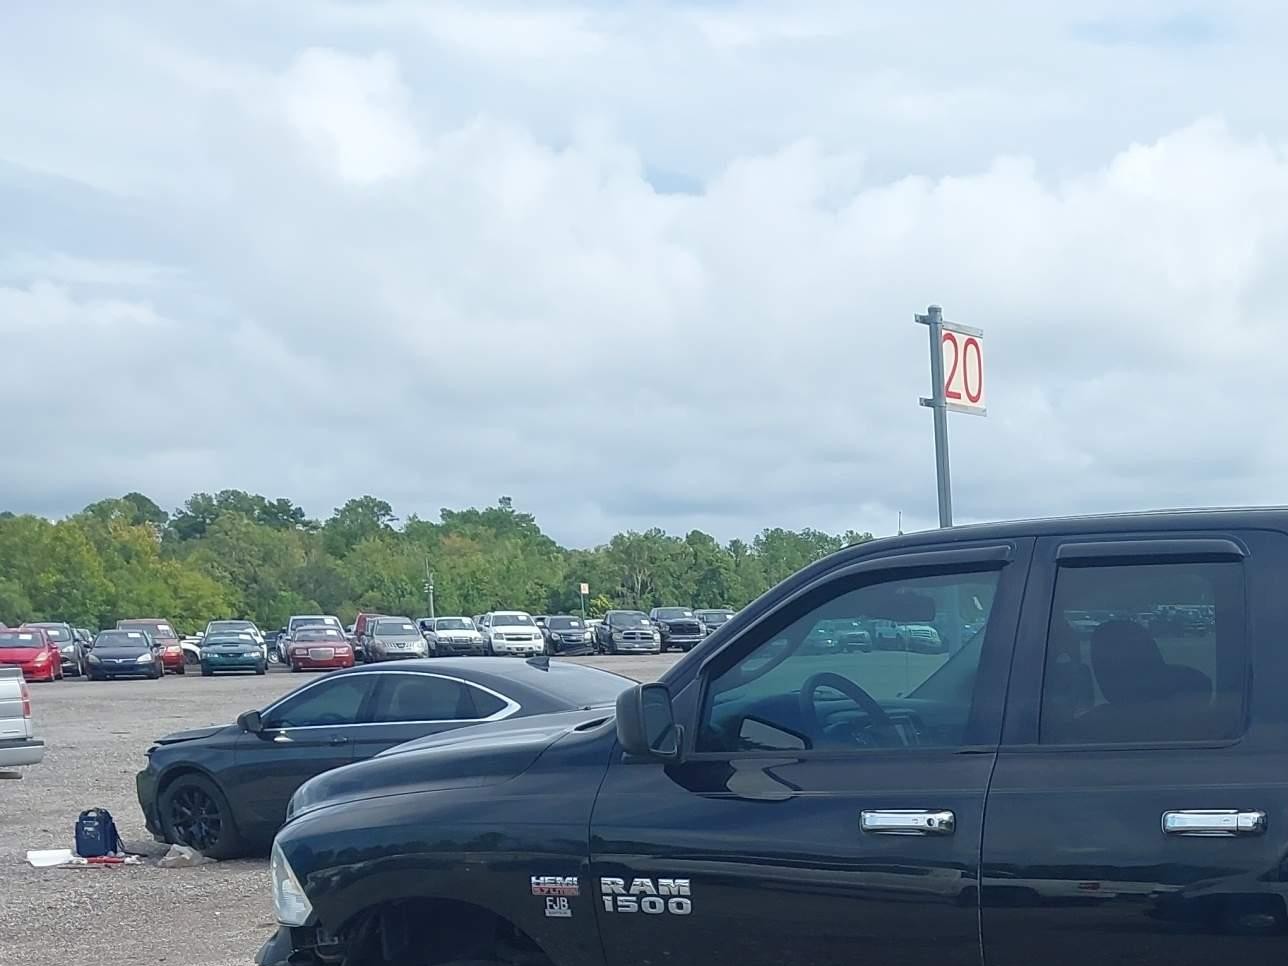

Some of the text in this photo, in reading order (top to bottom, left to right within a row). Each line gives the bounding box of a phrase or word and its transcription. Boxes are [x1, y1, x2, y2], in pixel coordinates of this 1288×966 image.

[943, 332, 982, 403] 20
[531, 876, 578, 886] HEMI
[600, 877, 691, 895] RAM
[546, 896, 569, 910] FJB
[602, 896, 692, 915] 1500
